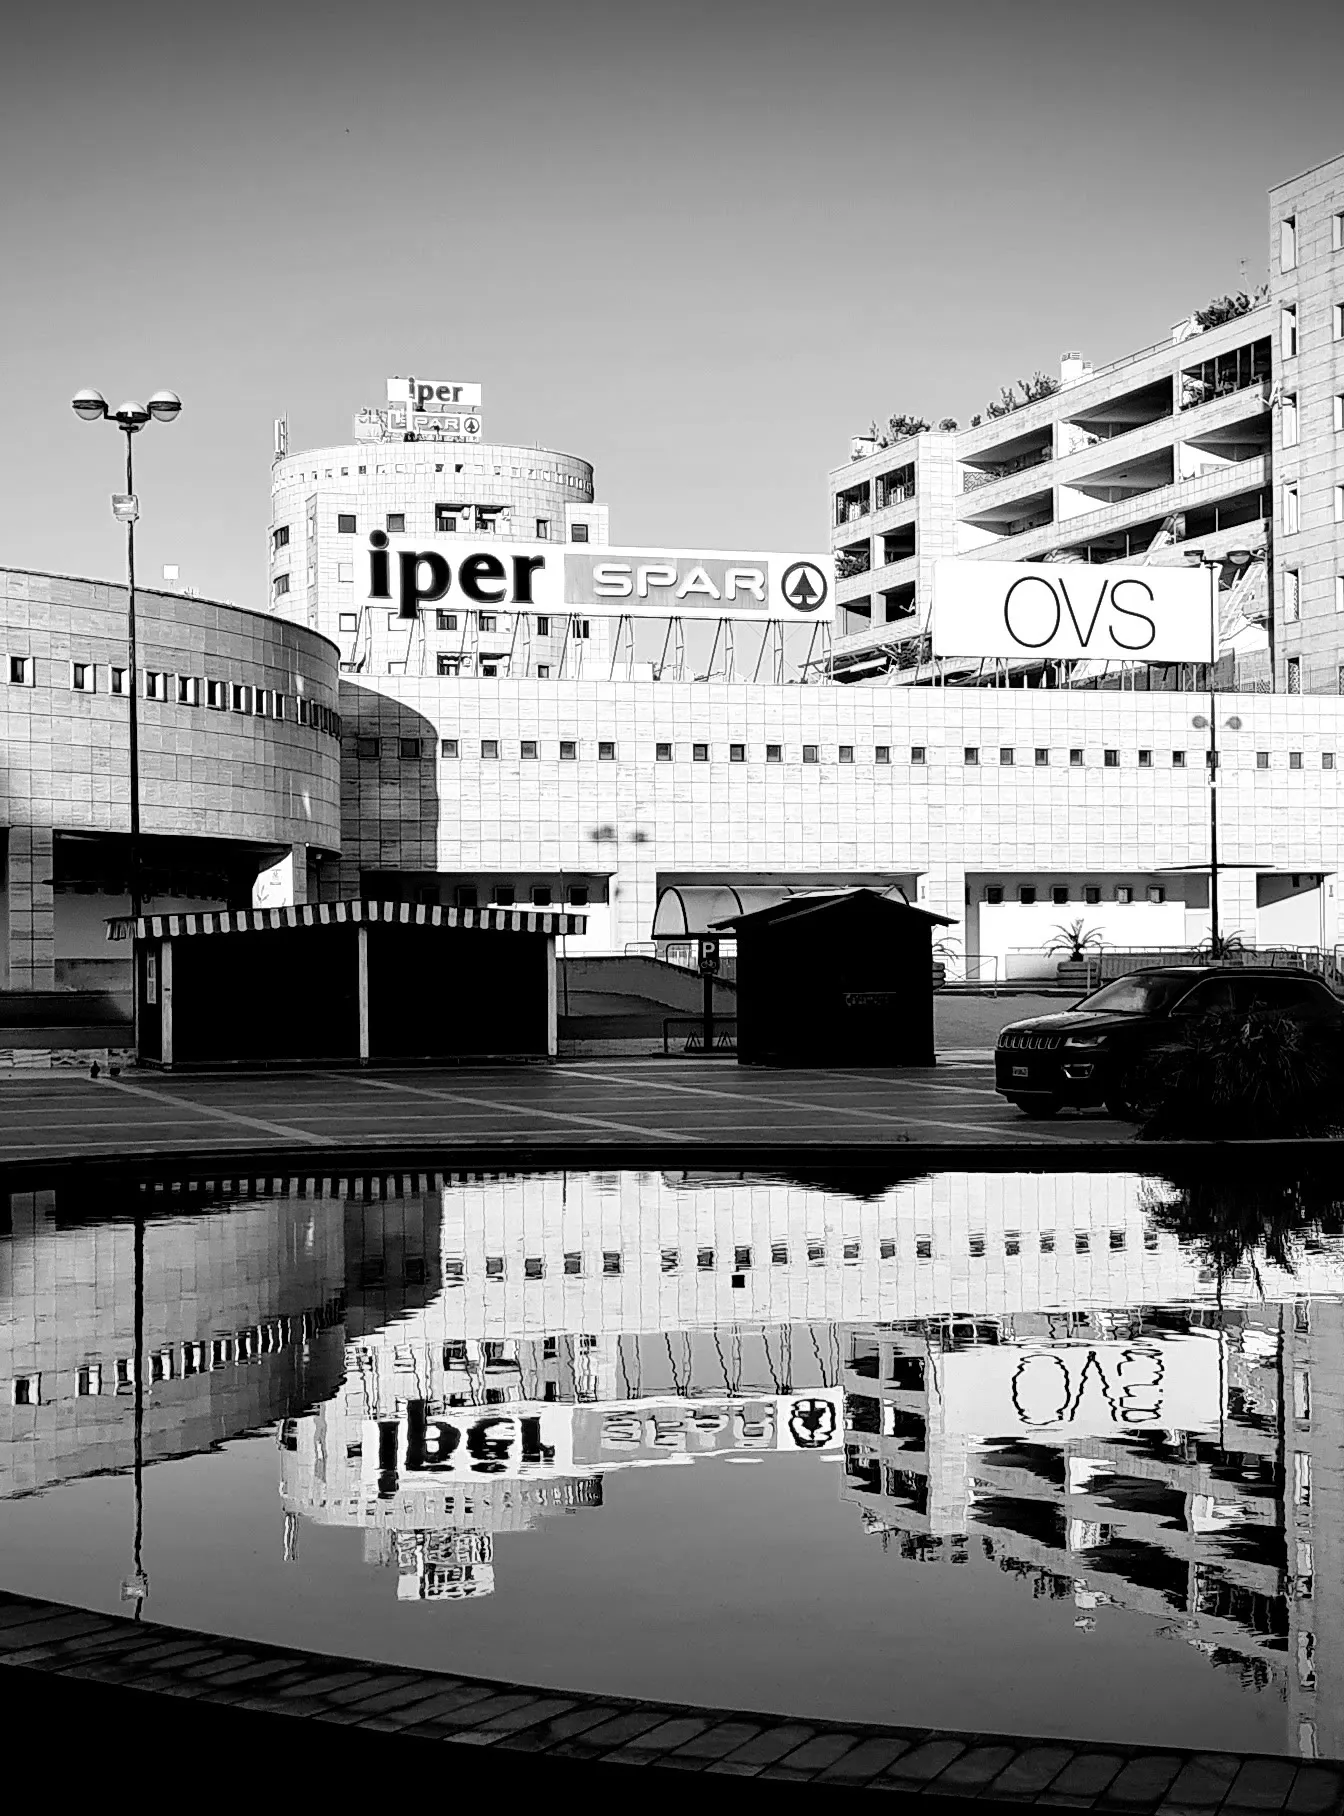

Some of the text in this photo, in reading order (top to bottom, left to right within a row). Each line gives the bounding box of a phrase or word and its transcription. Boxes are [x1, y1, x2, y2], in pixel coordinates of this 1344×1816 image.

[408, 376, 463, 407] iper
[367, 529, 767, 619] iper SPAR
[1003, 575, 1156, 651] OVS
[702, 941, 715, 959] P
